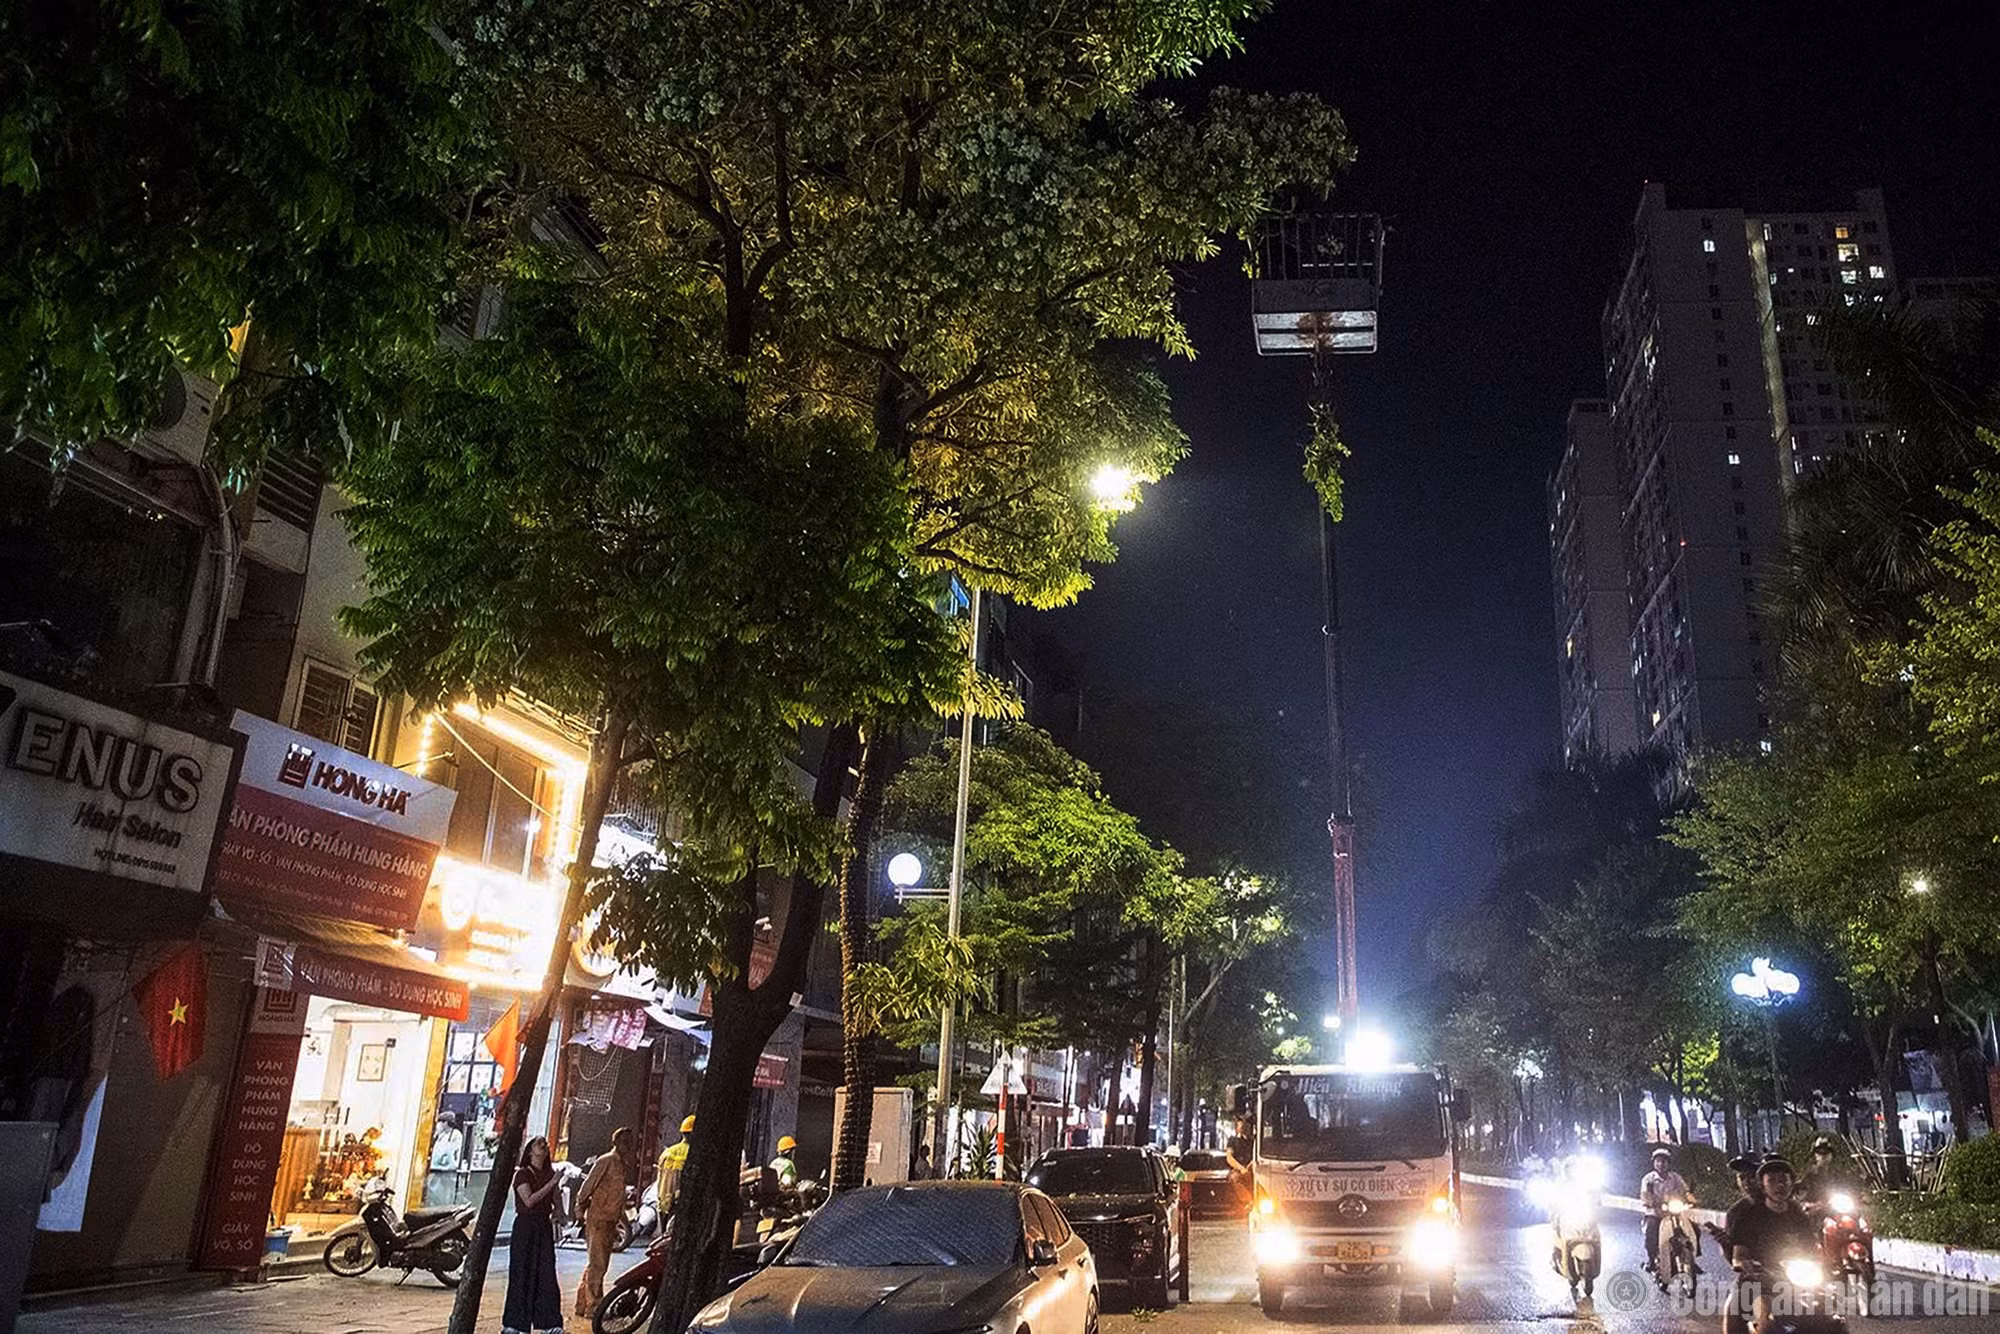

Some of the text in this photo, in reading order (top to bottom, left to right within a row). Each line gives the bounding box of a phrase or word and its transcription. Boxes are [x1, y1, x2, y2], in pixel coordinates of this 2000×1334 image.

[0, 684, 203, 814] ENUS
[72, 801, 183, 849] Hair Salon
